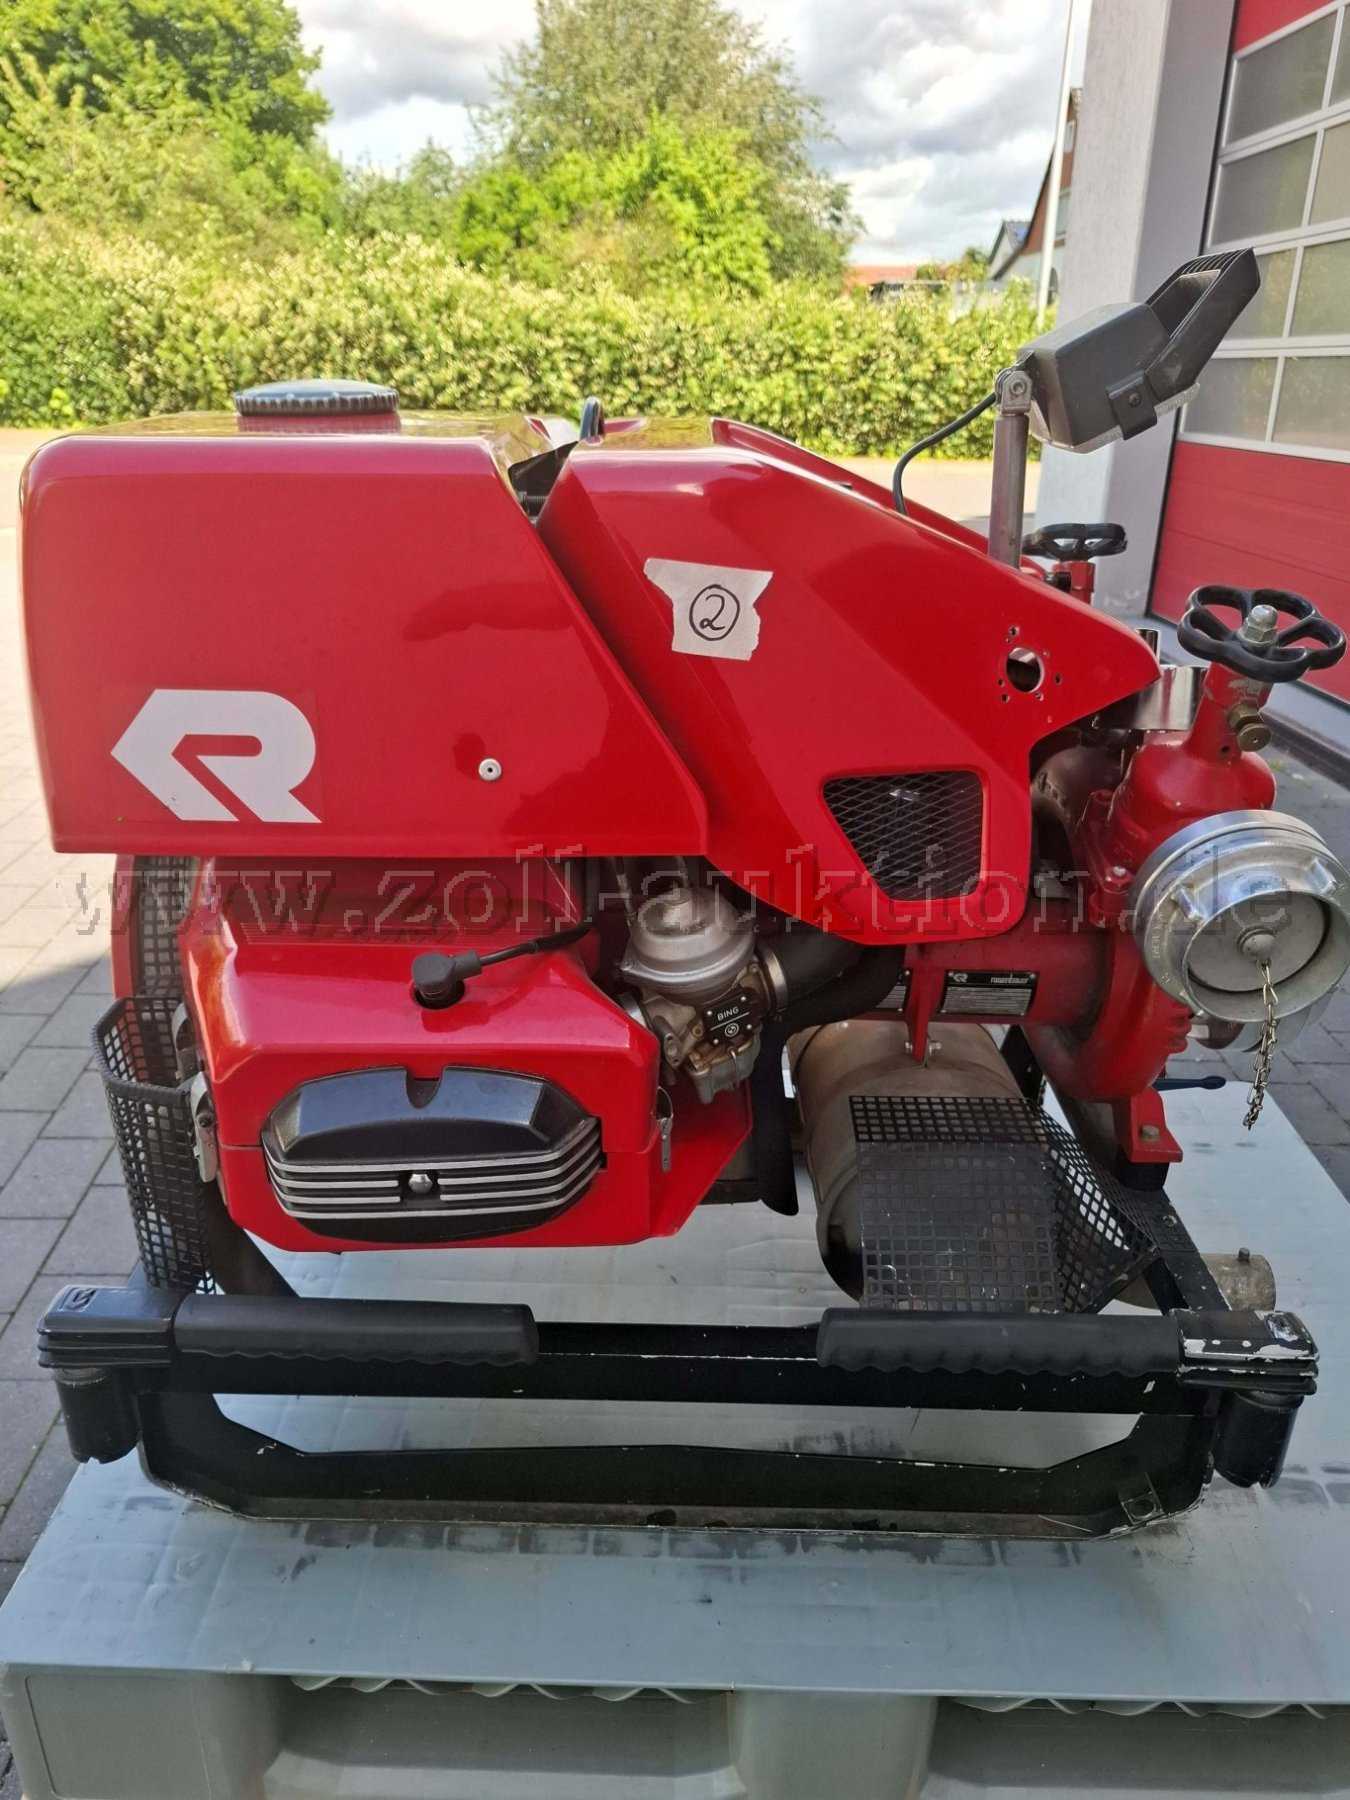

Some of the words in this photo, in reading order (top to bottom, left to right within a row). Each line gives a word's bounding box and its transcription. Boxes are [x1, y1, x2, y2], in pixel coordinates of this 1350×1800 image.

[699, 593, 726, 631] 2
[110, 688, 323, 824] R
[717, 1006, 739, 1021] BING
